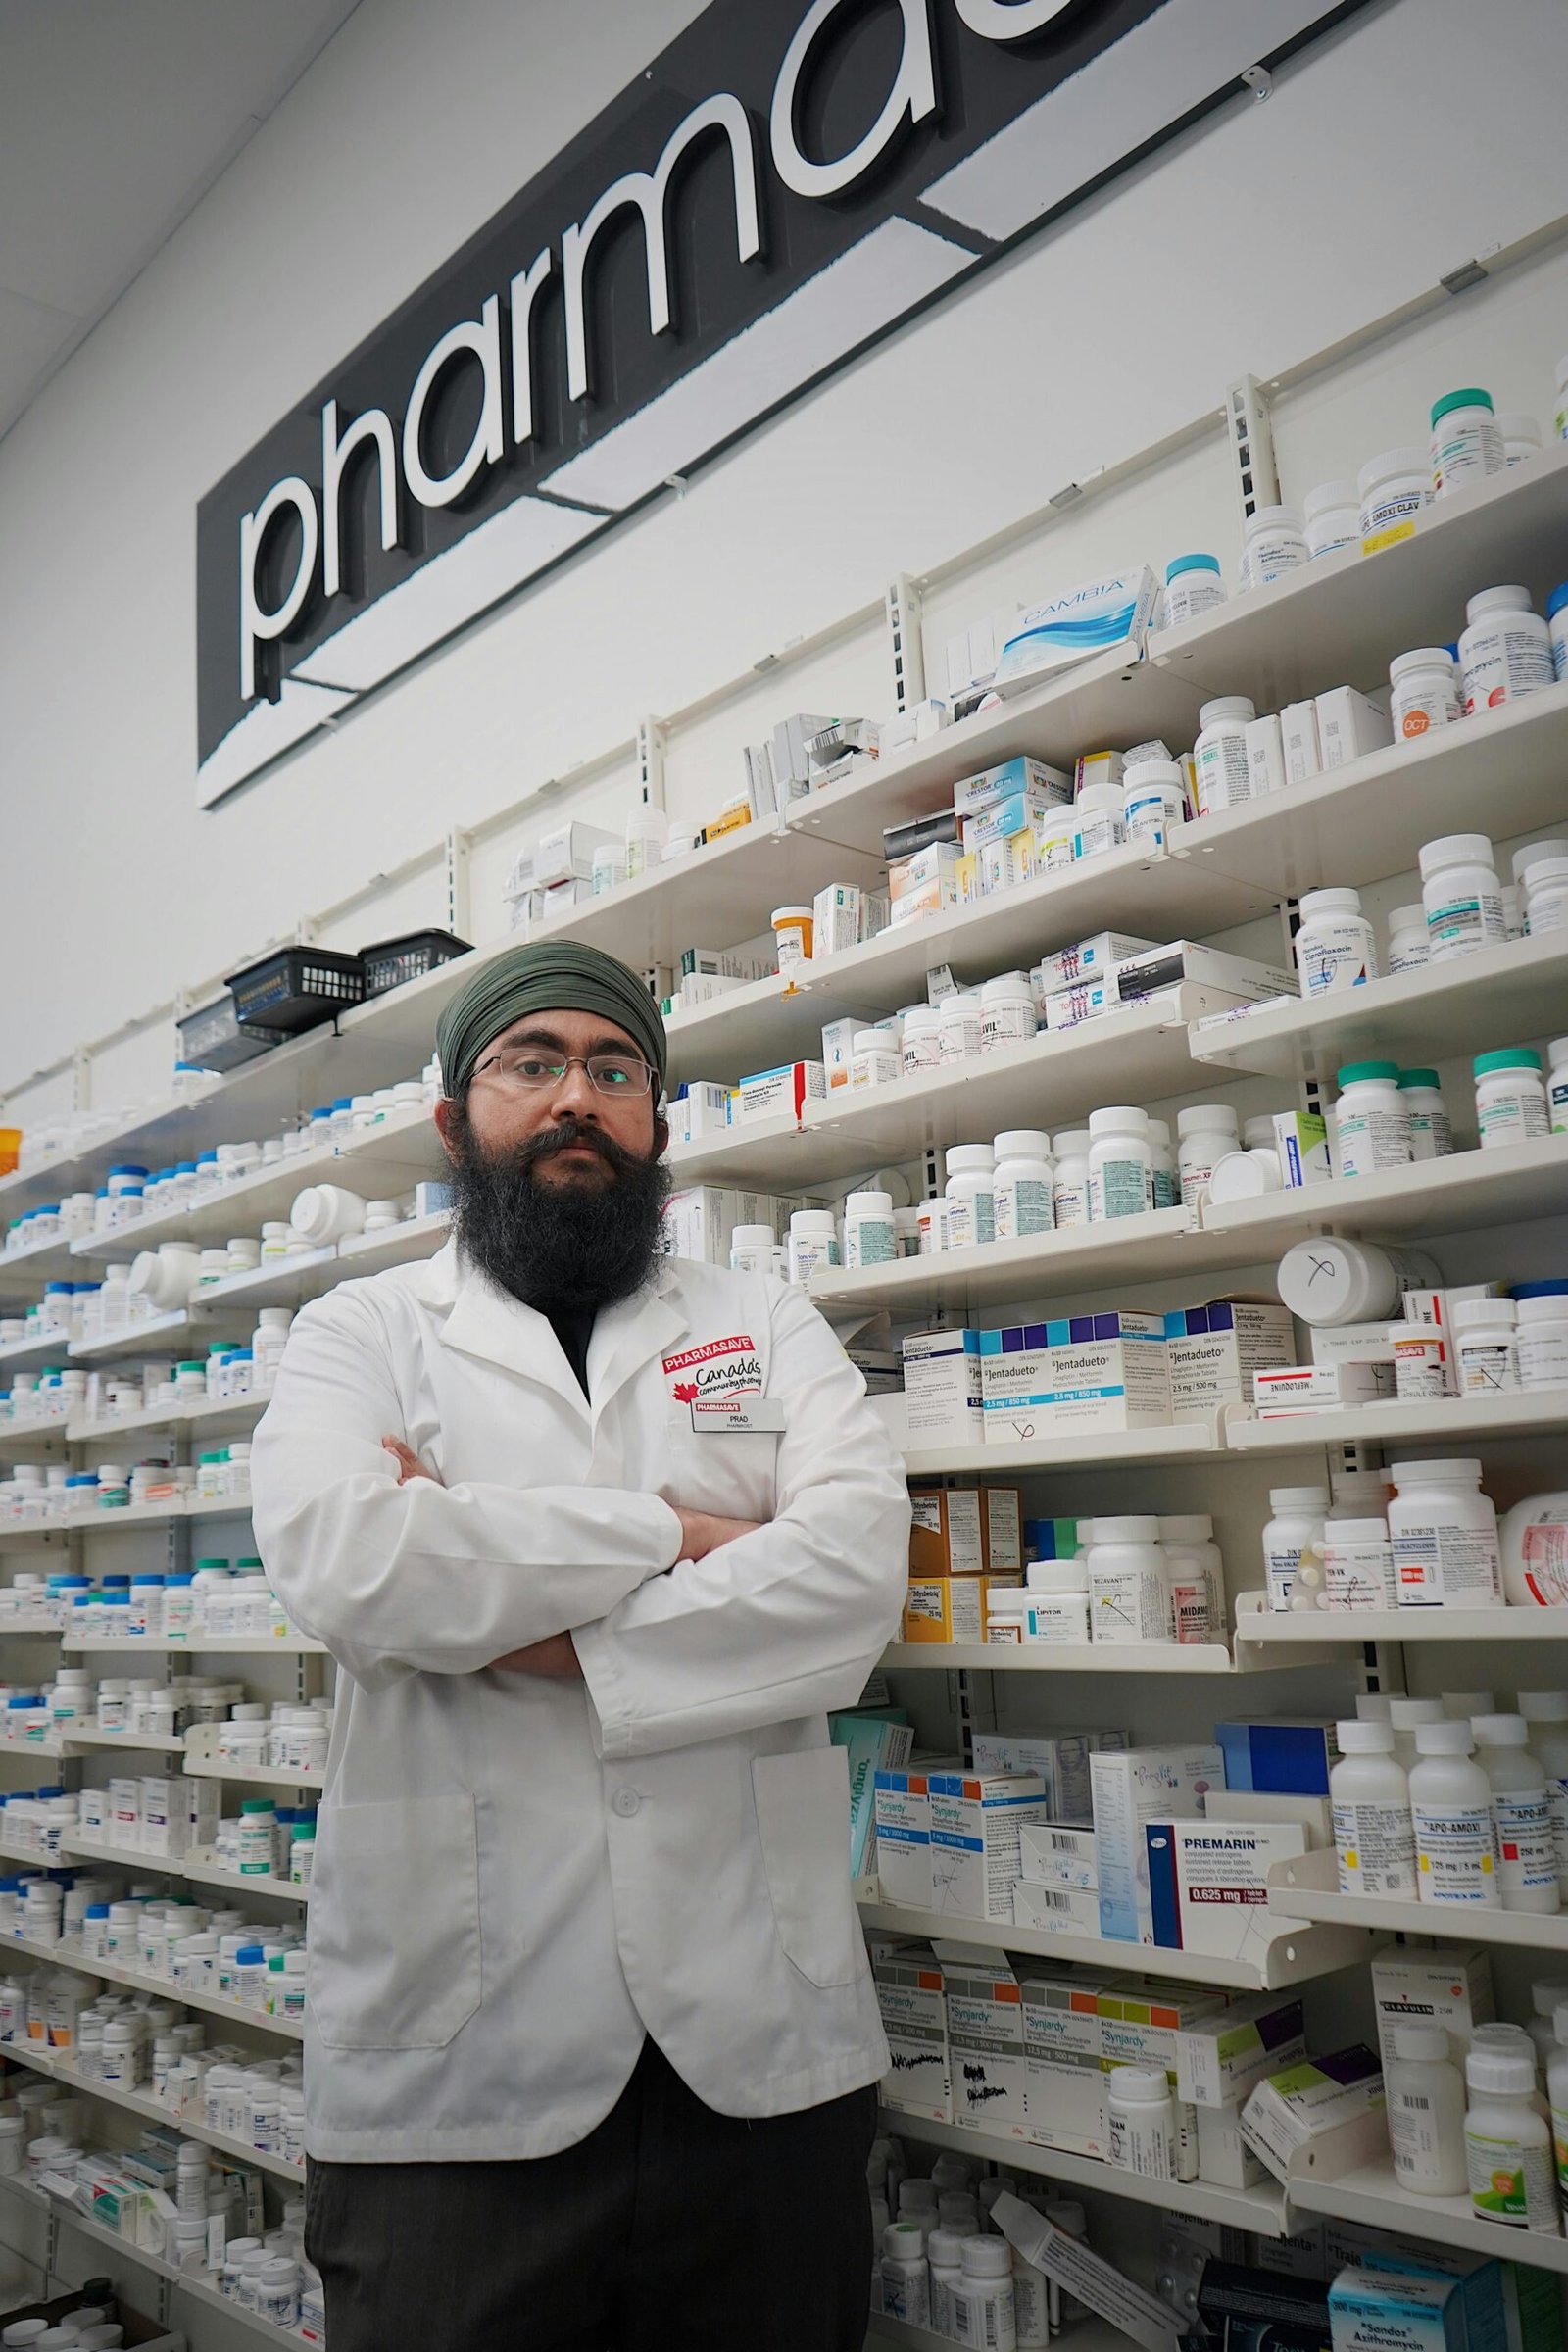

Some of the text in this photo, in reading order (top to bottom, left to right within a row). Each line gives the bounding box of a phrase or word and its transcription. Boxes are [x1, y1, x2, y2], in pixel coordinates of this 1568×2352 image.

[1024, 580, 1124, 625] CAMBIA
[666, 1337, 751, 1370] PHARMASAVE
[1174, 1348, 1222, 1364] Jentadueto
[696, 1357, 761, 1386] Canada's
[1056, 1356, 1106, 1372] Jentadueto
[988, 1366, 1036, 1381] Jentadueto
[1270, 1381, 1310, 1393] MEFLOQUINE
[850, 1760, 868, 1826] onglyza
[879, 1801, 906, 1816] Synjardy
[934, 1806, 962, 1821] Synjardy
[1429, 1821, 1480, 1833] APO-AMOXI
[1185, 1838, 1256, 1850] PREMARIN
[1445, 1862, 1458, 1873] mg
[1193, 1890, 1221, 1901] 0.625
[1223, 1892, 1241, 1903] mg
[882, 1994, 914, 2008] Synjardy
[1385, 2003, 1433, 2014] CLAVULIN
[955, 2007, 989, 2023] Synjardy
[1029, 2017, 1065, 2034] Synjardy
[1104, 2031, 1145, 2048] Synjardy
[1041, 2049, 1052, 2058] mg
[1055, 2051, 1067, 2060] 500
[1068, 2054, 1079, 2064] mg
[1367, 2324, 1407, 2338] Sandoz
[1354, 2332, 1424, 2350] Azithromycin
